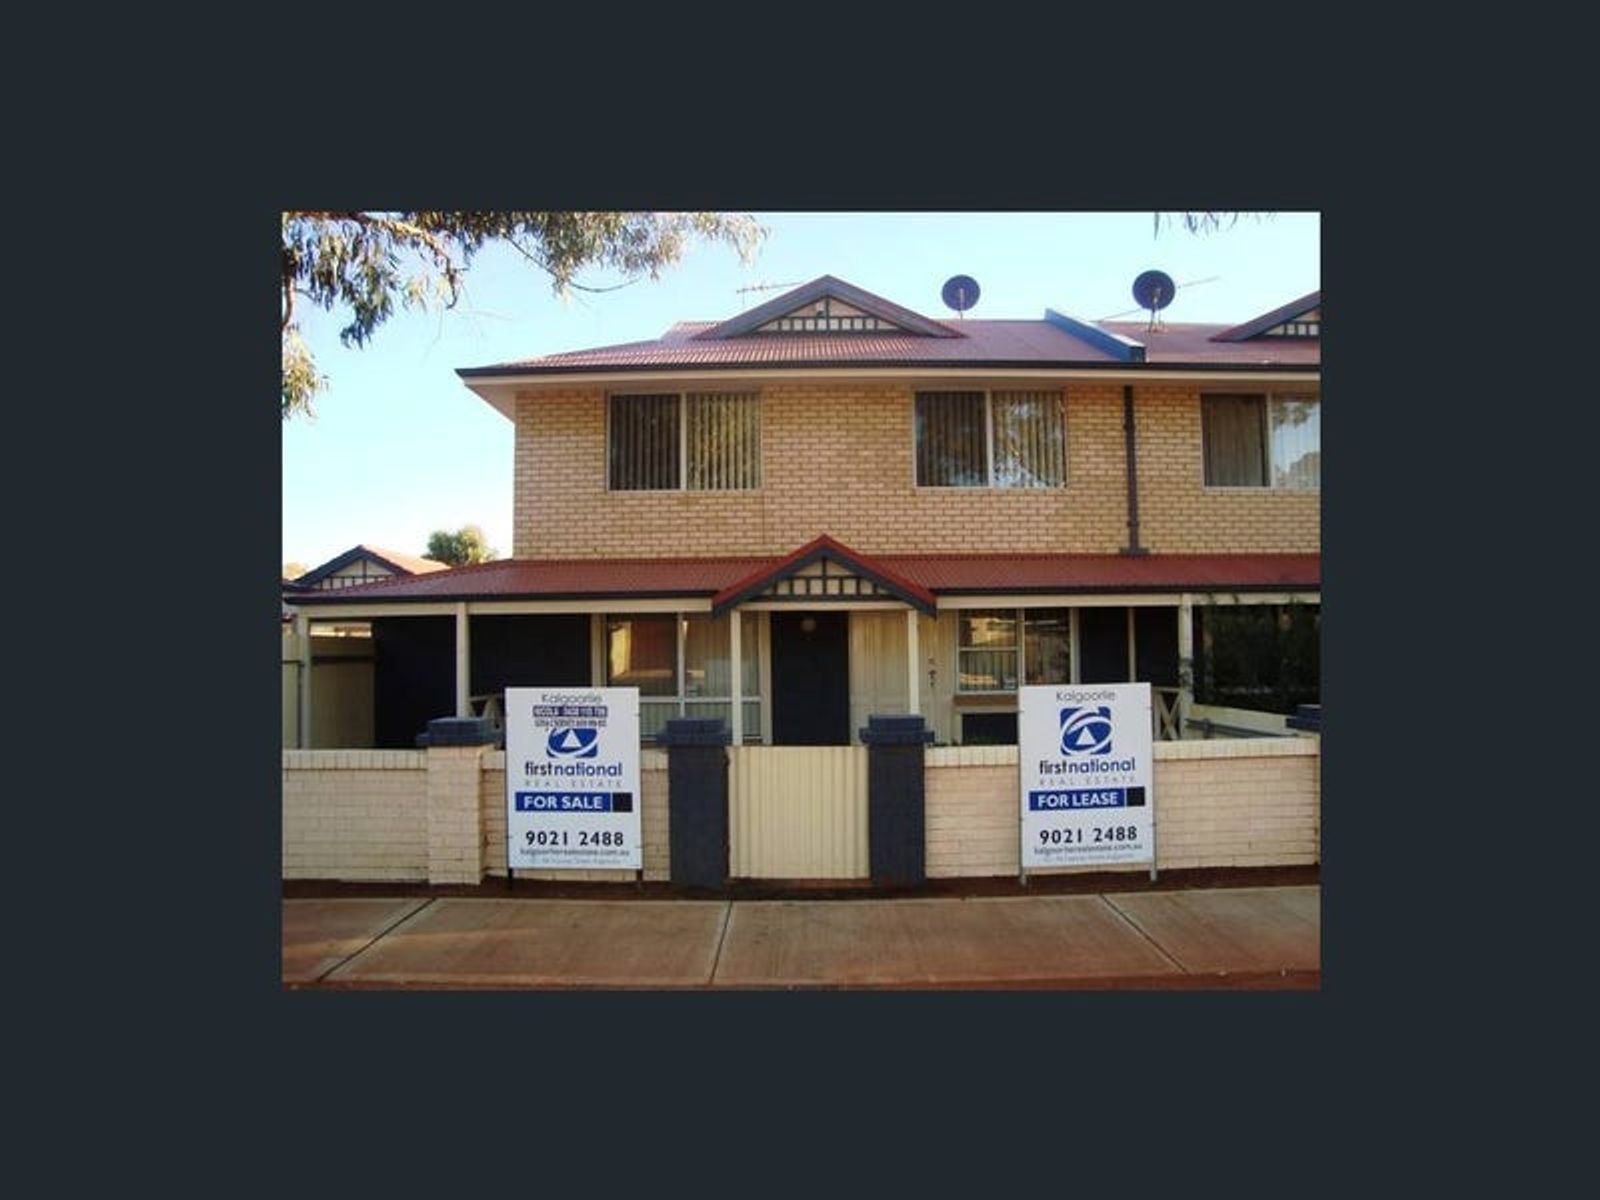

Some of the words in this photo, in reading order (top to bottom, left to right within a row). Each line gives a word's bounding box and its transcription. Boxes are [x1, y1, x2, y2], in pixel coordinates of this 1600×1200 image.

[1056, 690, 1116, 703] Kalgoorlie
[524, 795, 558, 809] FOR
[561, 796, 604, 809] SALE
[1038, 794, 1069, 808] FOR
[1072, 791, 1119, 806] LEASE
[525, 830, 568, 846] 9021
[579, 831, 624, 846] 2488
[1039, 828, 1083, 845] 9021
[1093, 826, 1137, 843] 2488
